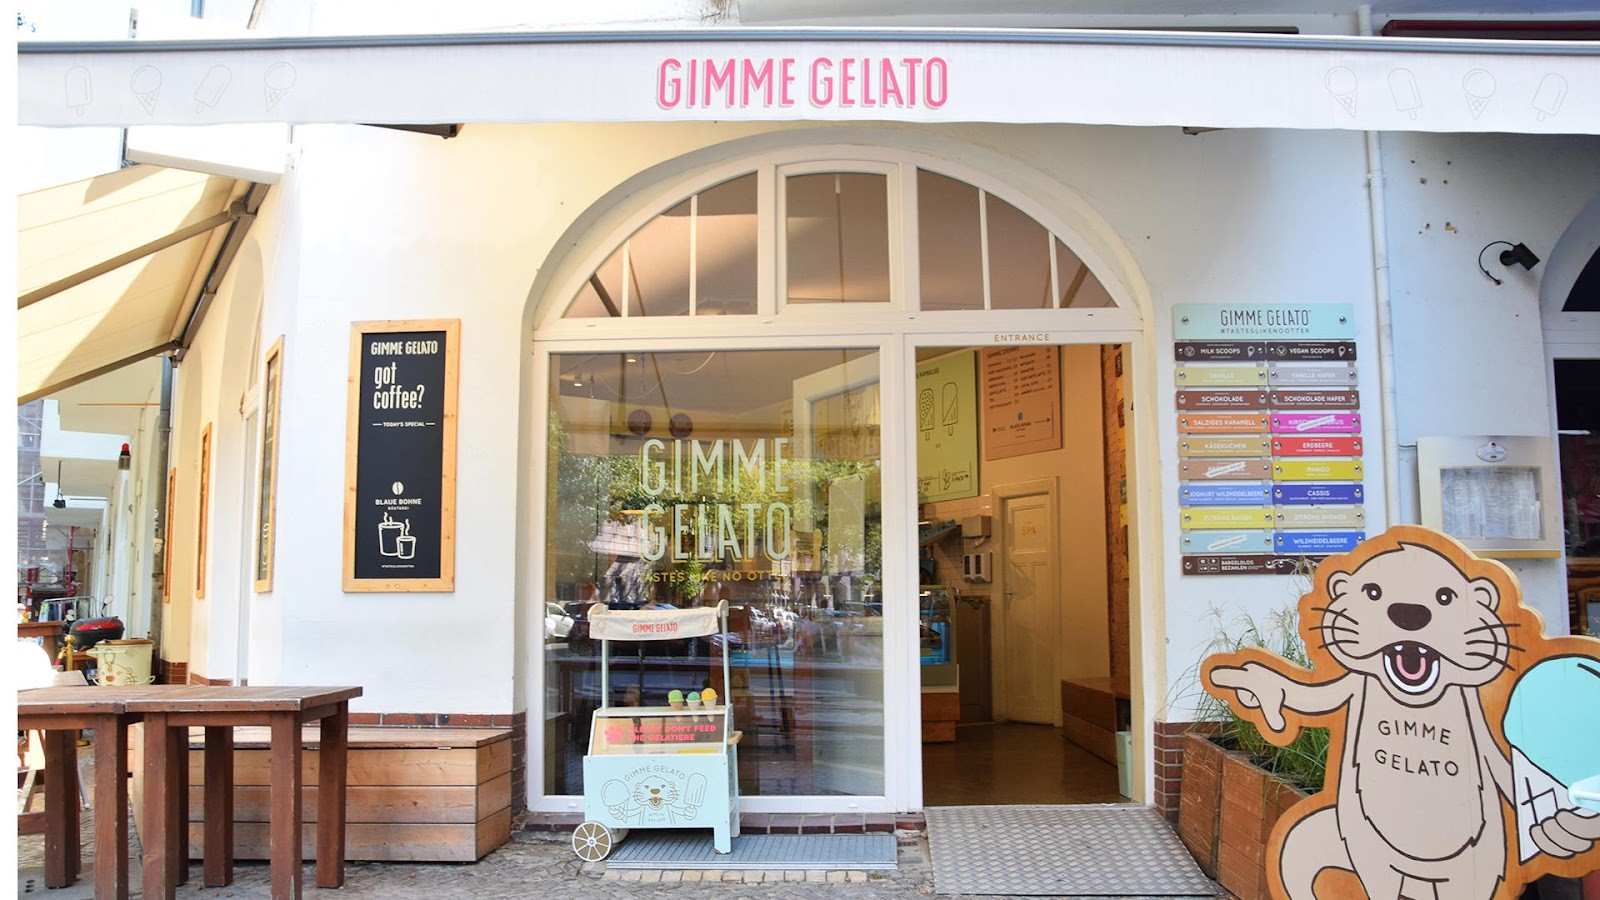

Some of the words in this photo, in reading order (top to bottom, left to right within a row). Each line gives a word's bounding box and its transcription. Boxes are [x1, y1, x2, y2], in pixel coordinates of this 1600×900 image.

[656, 57, 796, 110] GIMME
[808, 56, 949, 111] GELATO
[1220, 310, 1262, 326] GIMME
[1267, 310, 1310, 326] GELATO
[371, 341, 403, 355] GIMME
[406, 340, 439, 354] GELATO
[994, 334, 1050, 342] ENTRANCE
[374, 362, 397, 390] got
[373, 385, 425, 410] coffee?
[638, 437, 790, 500] GIMME
[638, 503, 792, 565] GELATO
[1022, 525, 1036, 535] SPA
[722, 570, 742, 582] NO
[632, 623, 654, 634] GIMME
[656, 622, 678, 632] GELATO
[1378, 720, 1452, 746] GIMME
[624, 764, 652, 782] GIMME
[653, 764, 686, 780] GELATO
[1374, 749, 1460, 777] GELATO
